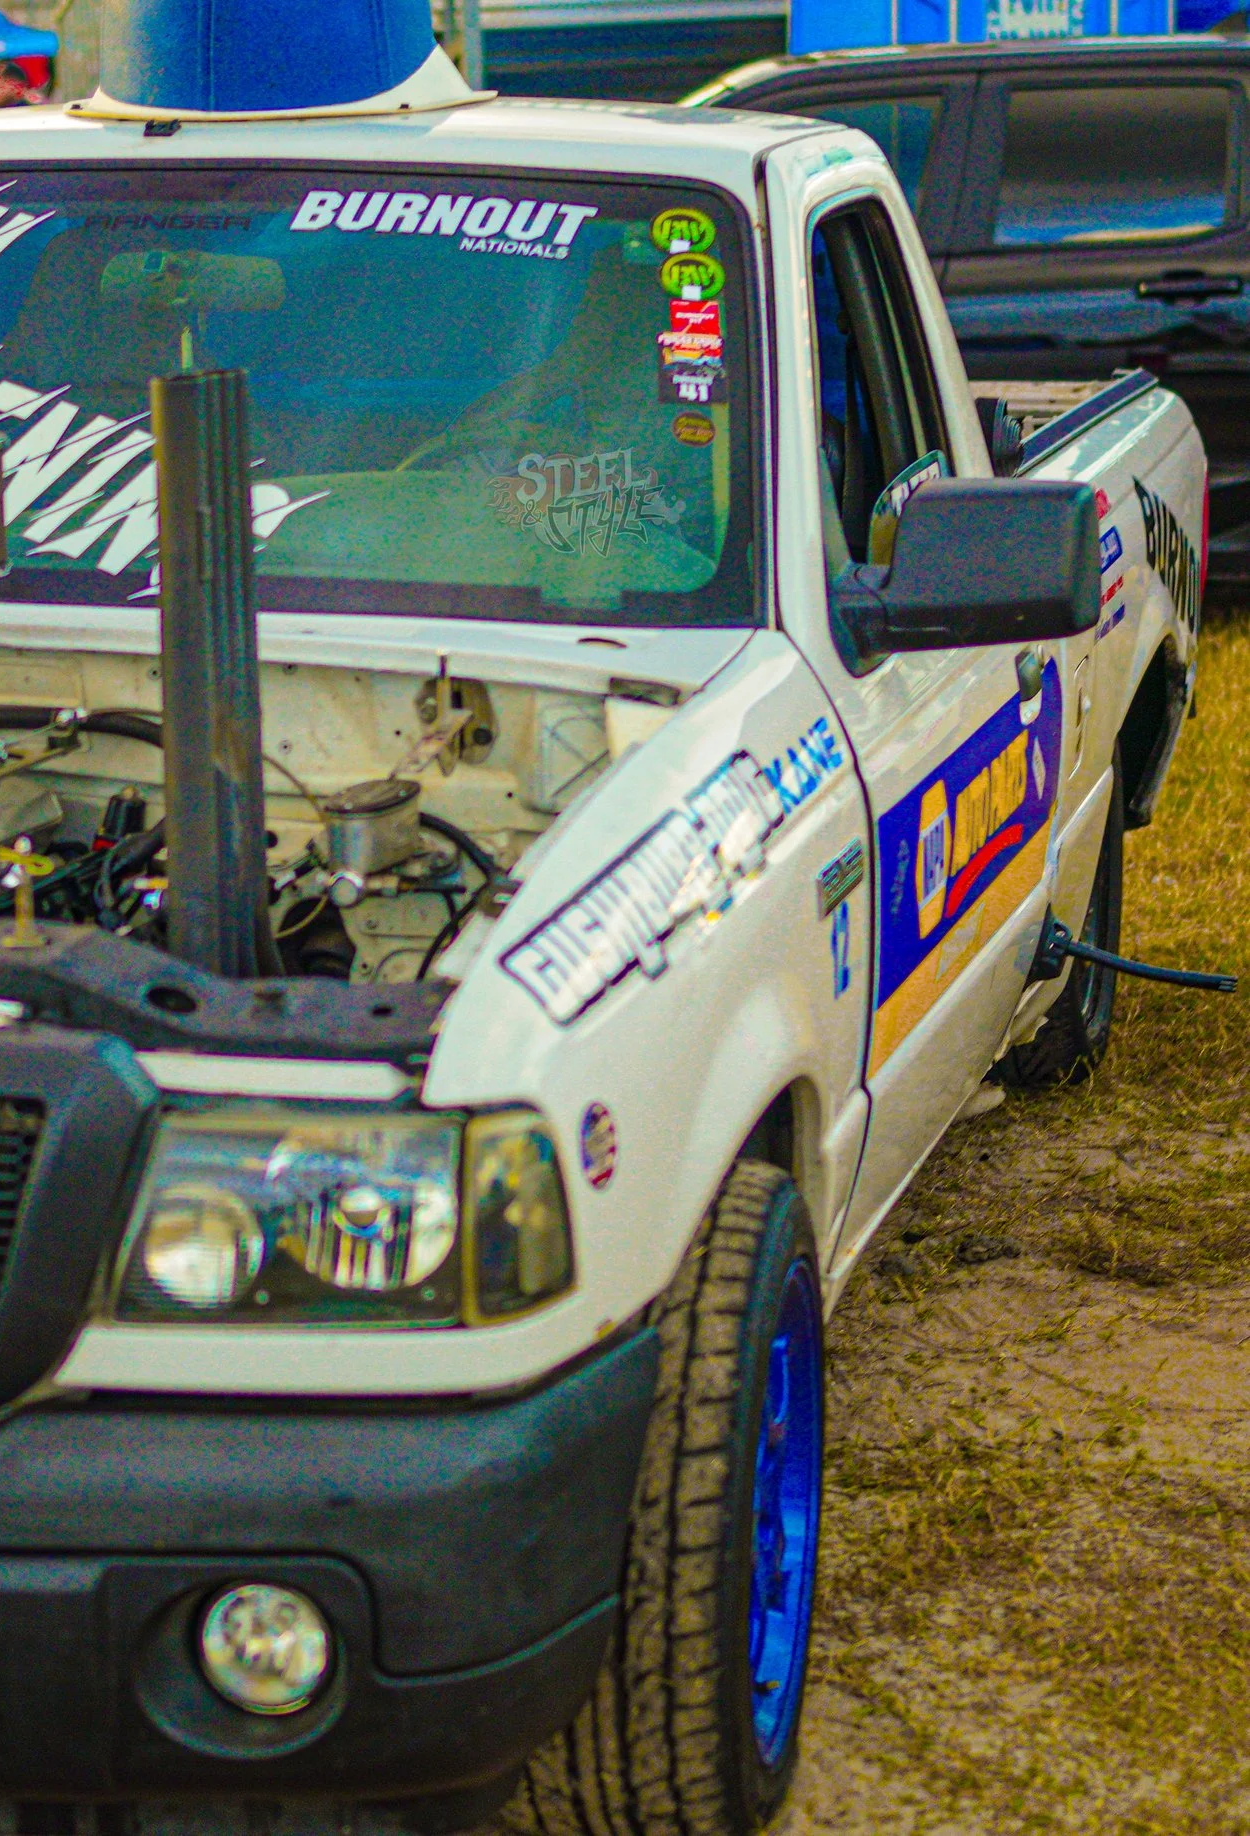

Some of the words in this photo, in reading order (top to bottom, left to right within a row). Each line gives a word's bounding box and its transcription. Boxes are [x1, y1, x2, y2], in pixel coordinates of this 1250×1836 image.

[290, 190, 598, 246] BURNOUT
[459, 237, 569, 261] NATIONALS
[517, 446, 652, 506] STEEL
[544, 482, 666, 558] STYLE
[1131, 474, 1202, 635] BURNO
[762, 716, 844, 815] KANE
